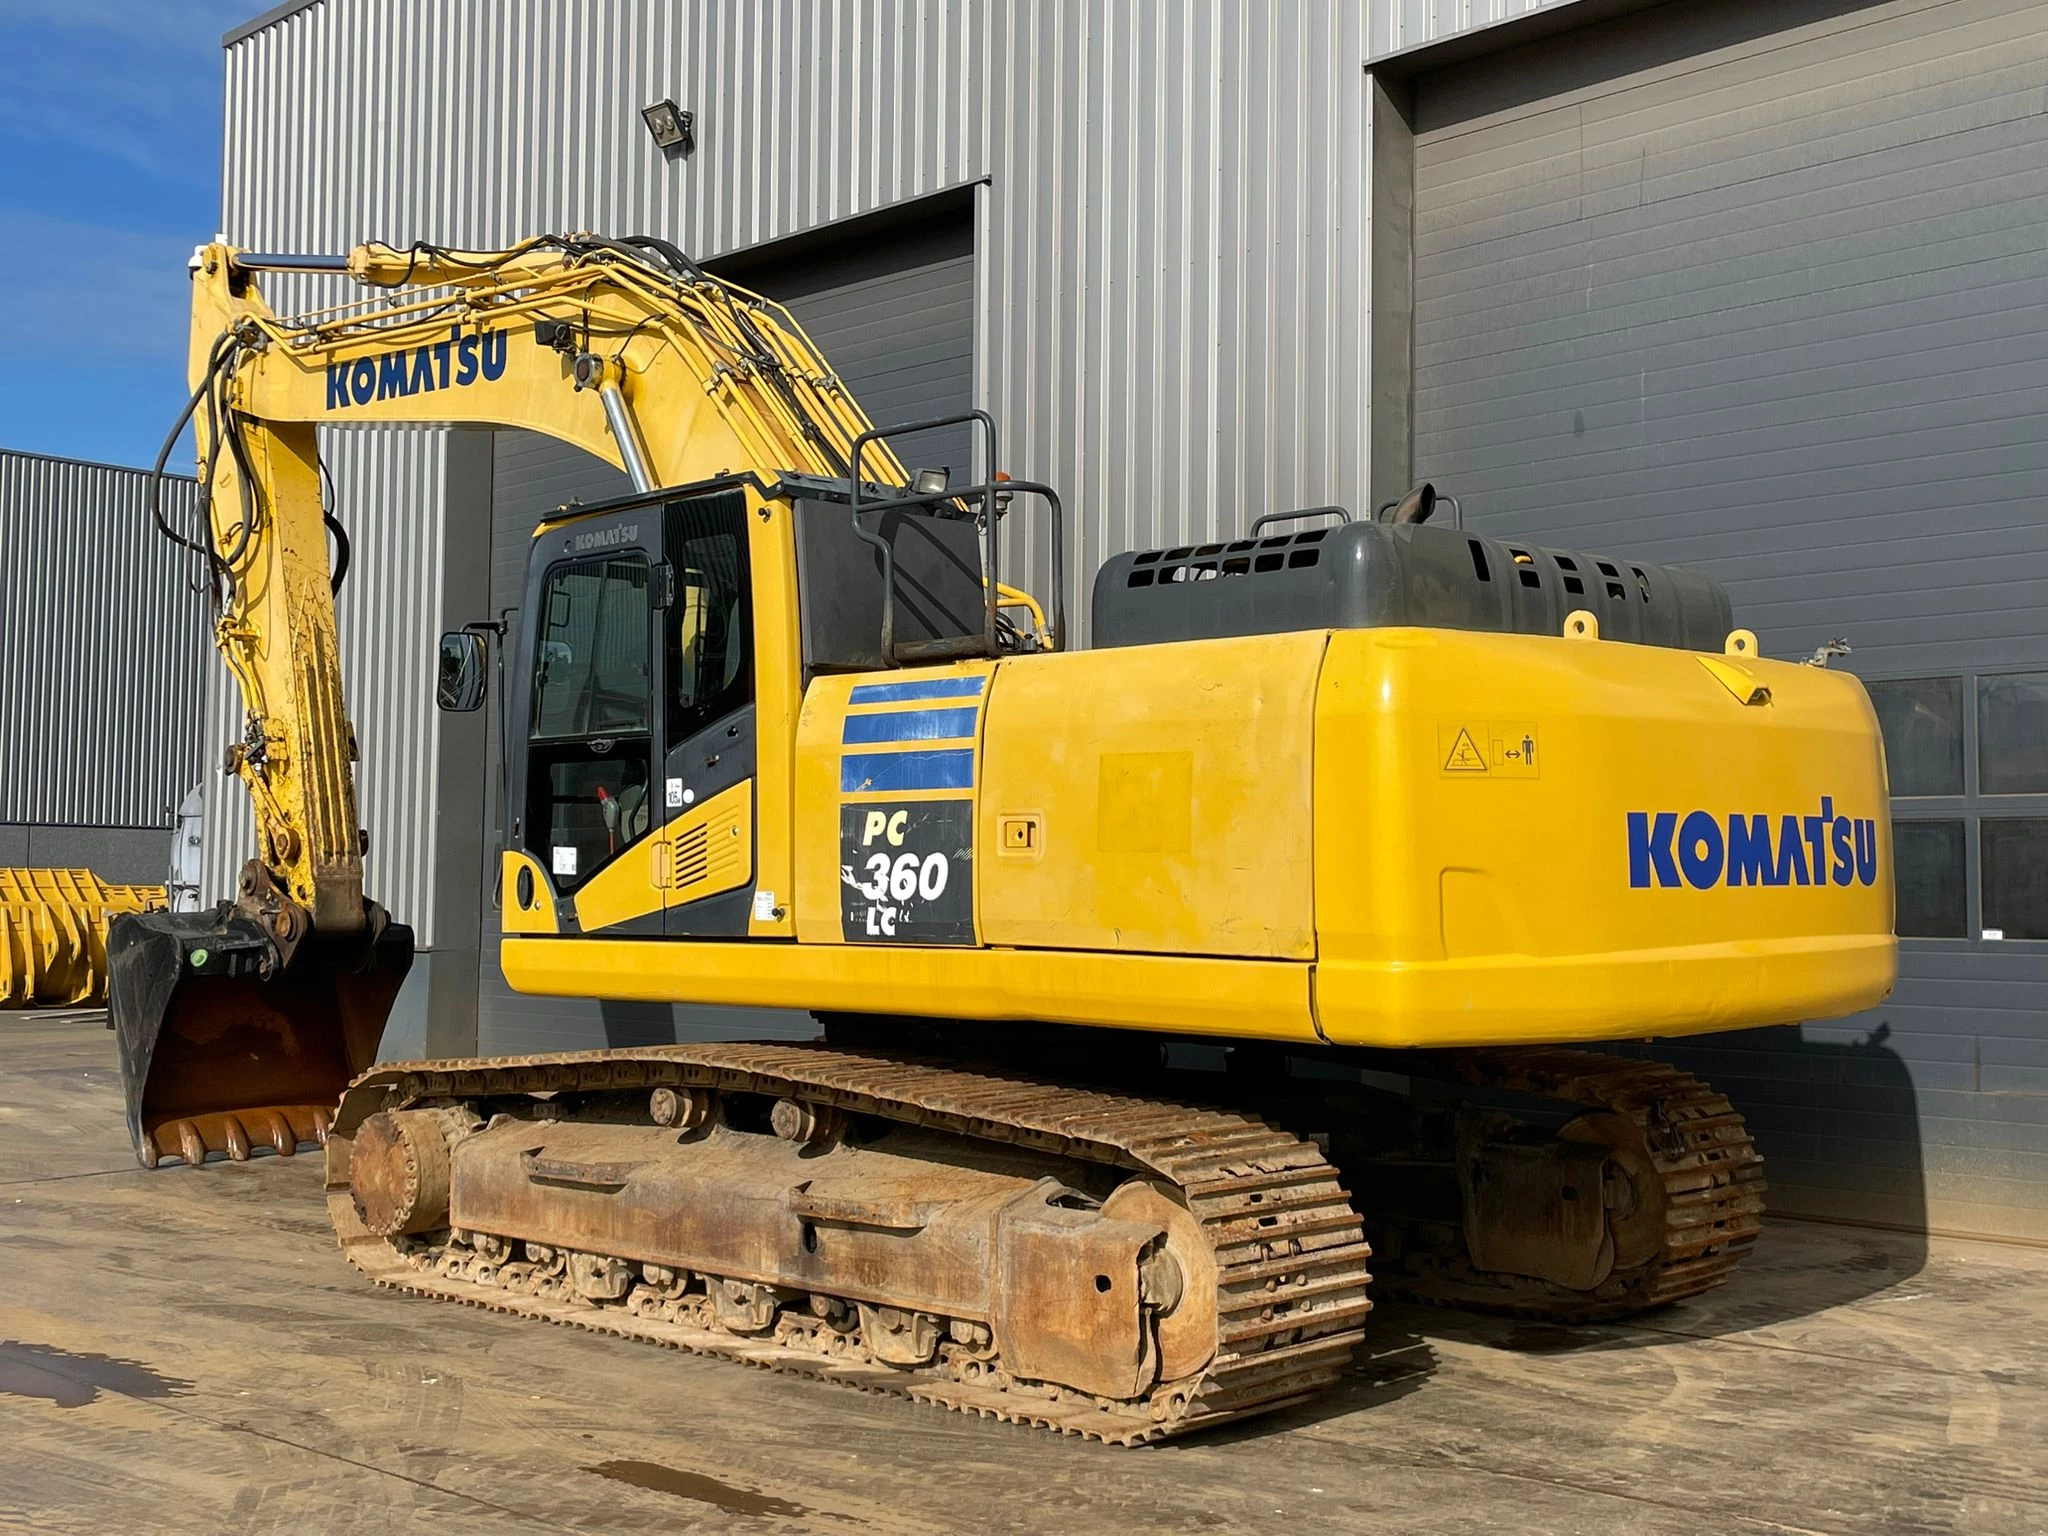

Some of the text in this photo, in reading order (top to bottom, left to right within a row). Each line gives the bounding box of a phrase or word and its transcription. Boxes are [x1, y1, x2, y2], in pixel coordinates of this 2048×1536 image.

[326, 324, 507, 410] KOMATSU
[575, 523, 639, 551] KOMATSU
[862, 810, 908, 846] PC
[1627, 795, 1877, 890] KOMATSU
[862, 852, 949, 901] 360
[866, 906, 897, 936] LC
